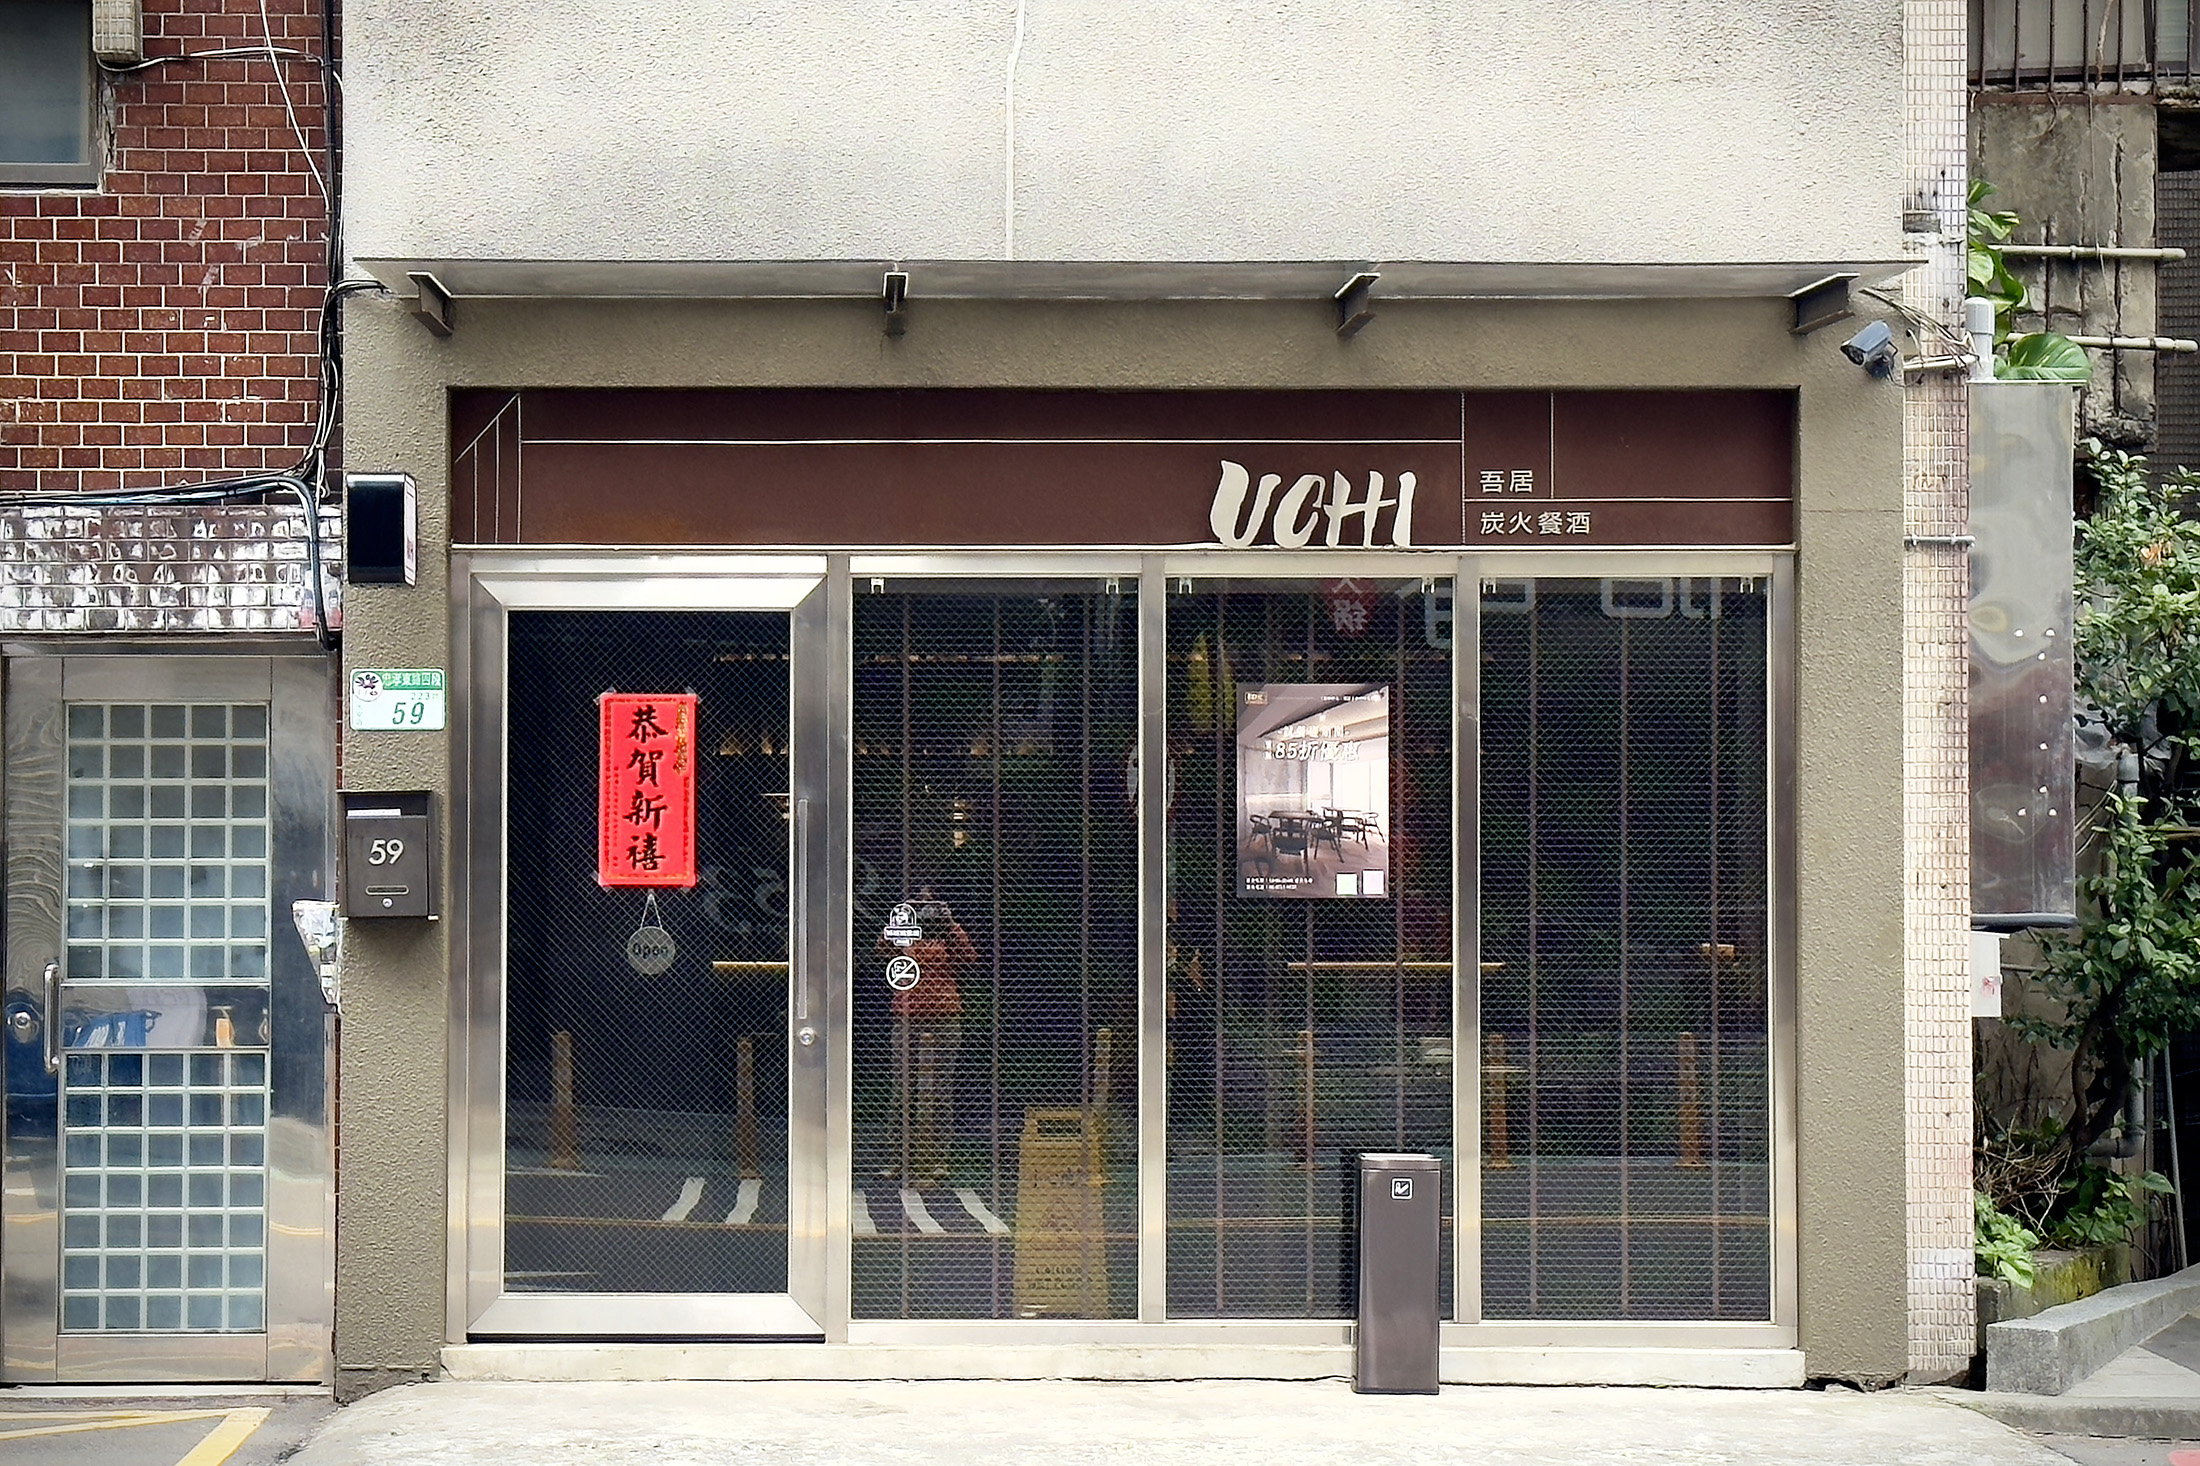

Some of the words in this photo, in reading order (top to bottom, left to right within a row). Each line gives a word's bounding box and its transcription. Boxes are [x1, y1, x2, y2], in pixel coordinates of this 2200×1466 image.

[1480, 470, 1534, 493] 吾居
[1210, 460, 1417, 548] UCHI
[1480, 511, 1591, 535] 炭火餐酒
[392, 702, 425, 725] 59
[623, 704, 668, 871] 恭賀新禧
[368, 838, 404, 865] 59
